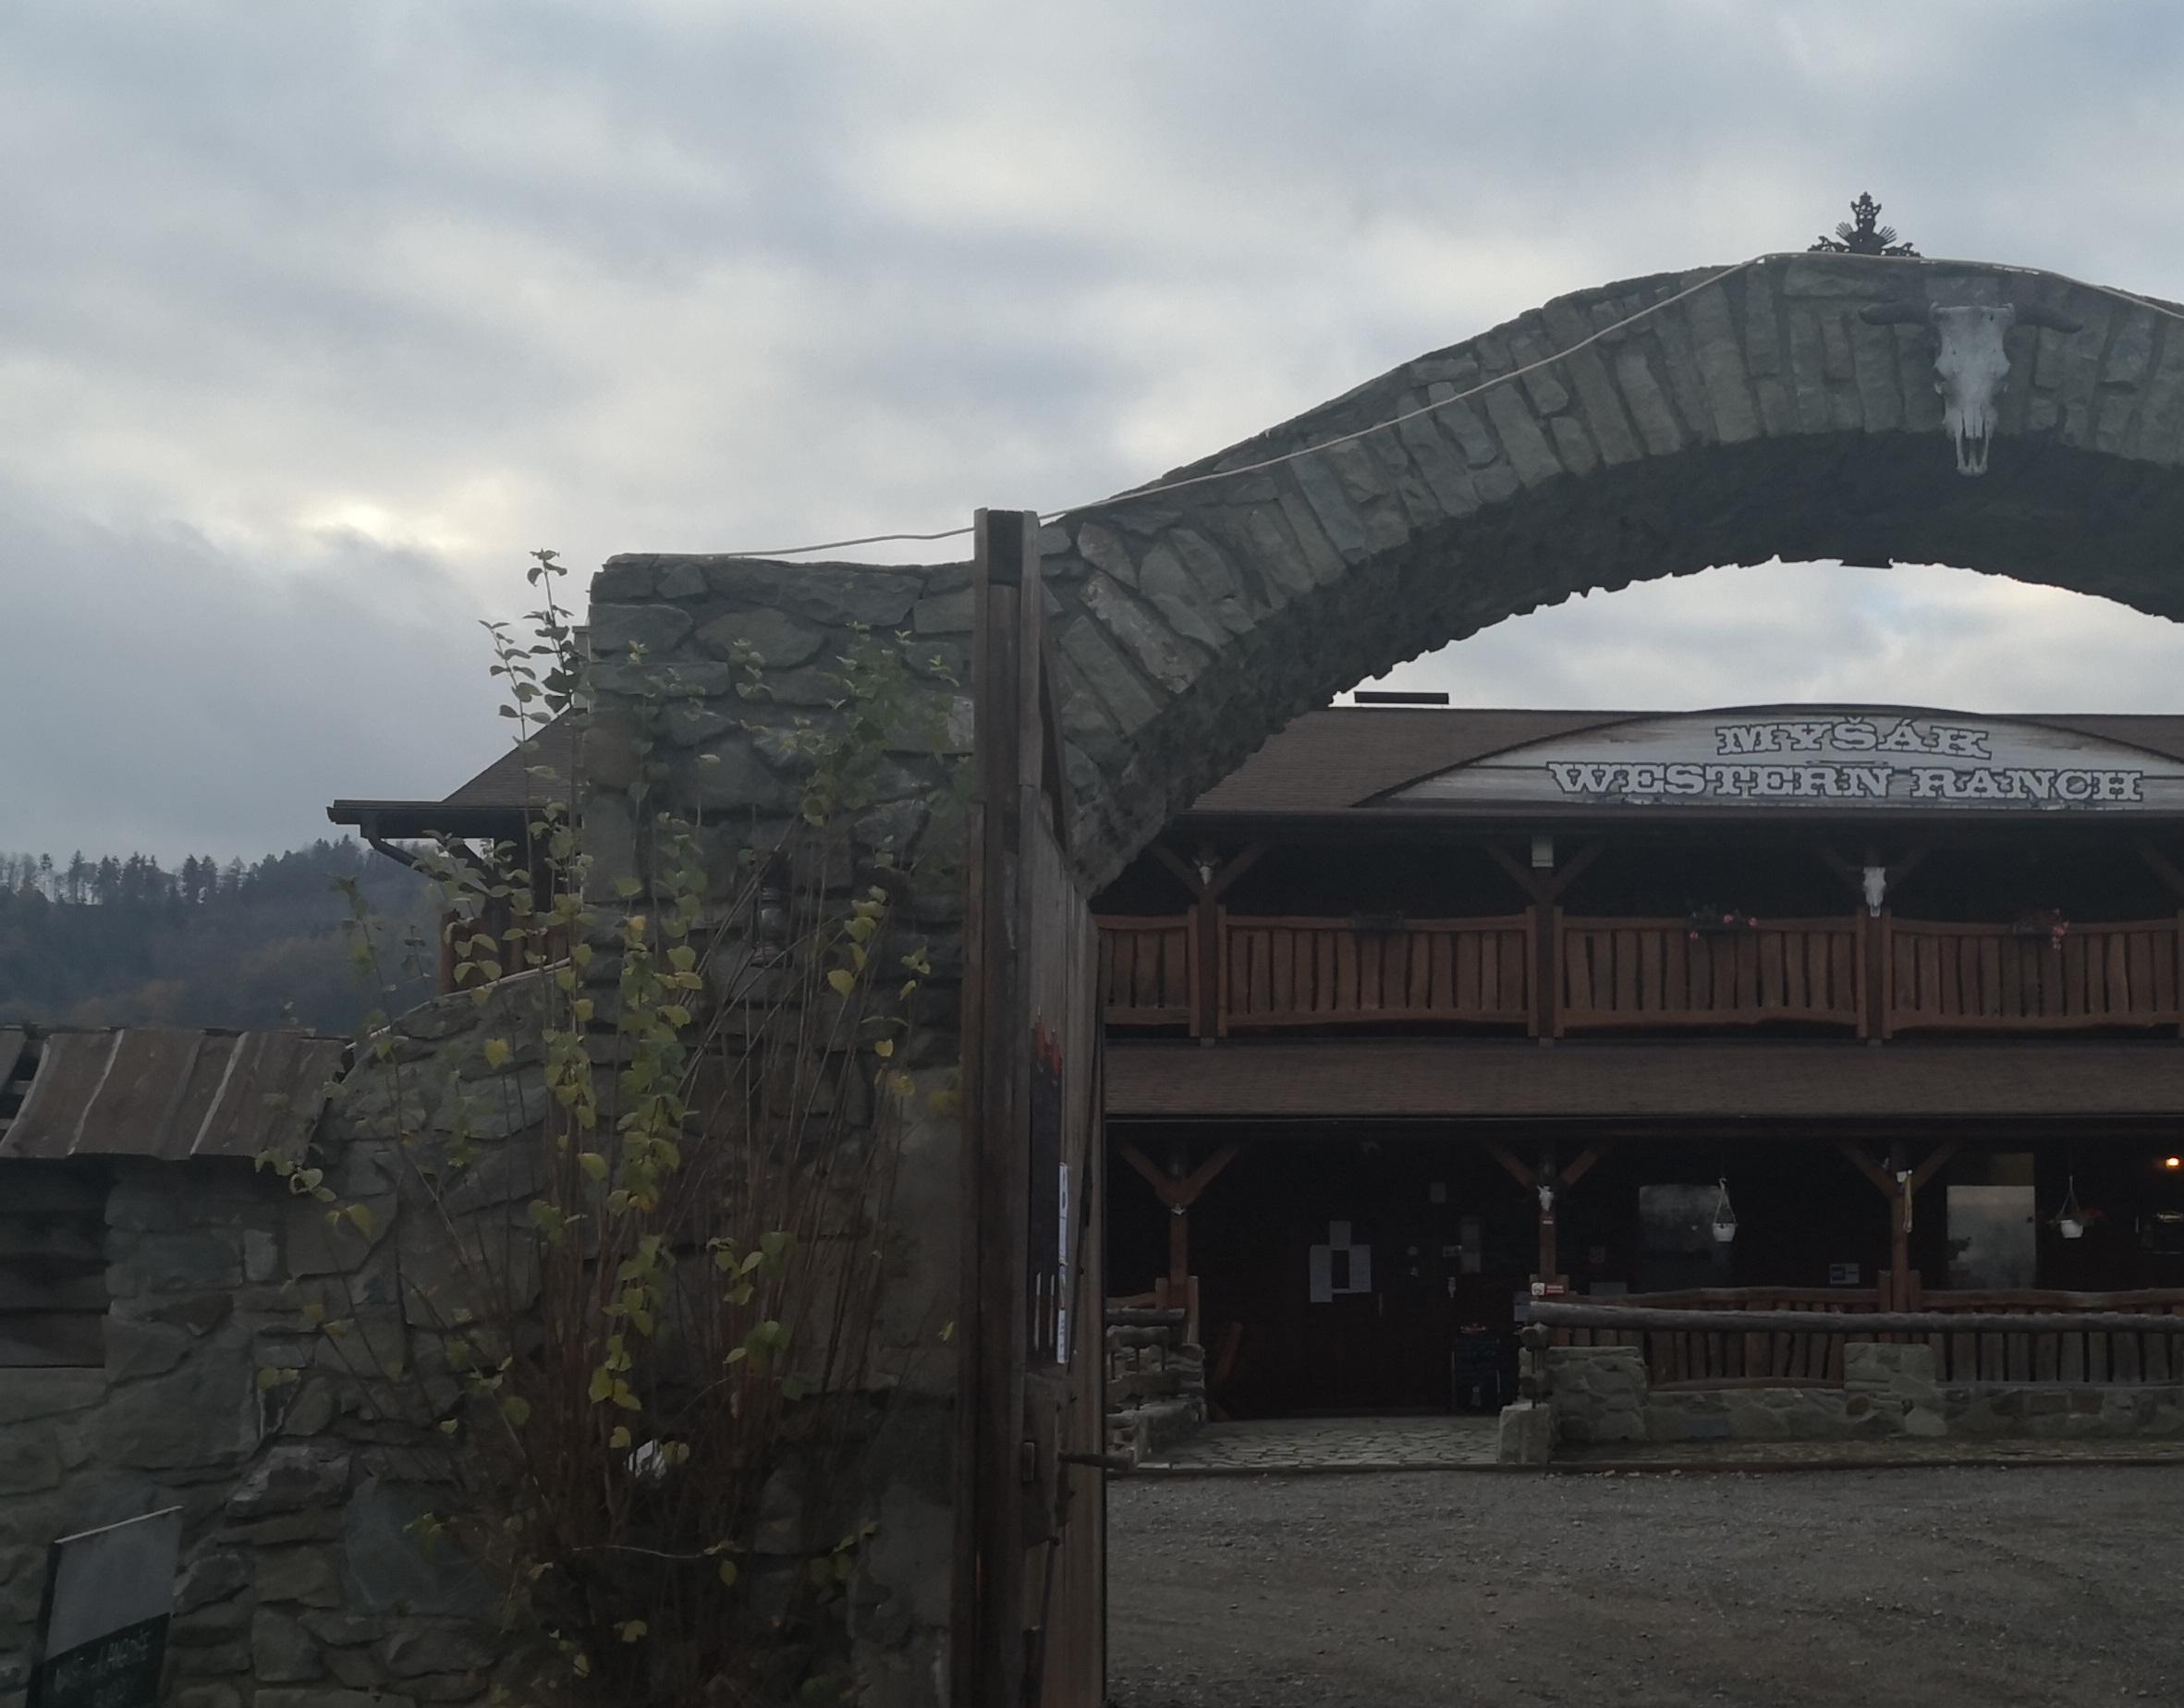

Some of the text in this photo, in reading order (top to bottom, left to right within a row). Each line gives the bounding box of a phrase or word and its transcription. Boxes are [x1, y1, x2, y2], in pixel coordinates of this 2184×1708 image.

[1715, 716, 1992, 760] MYŠÁK
[1547, 762, 2143, 800] WESTERN RANCH
